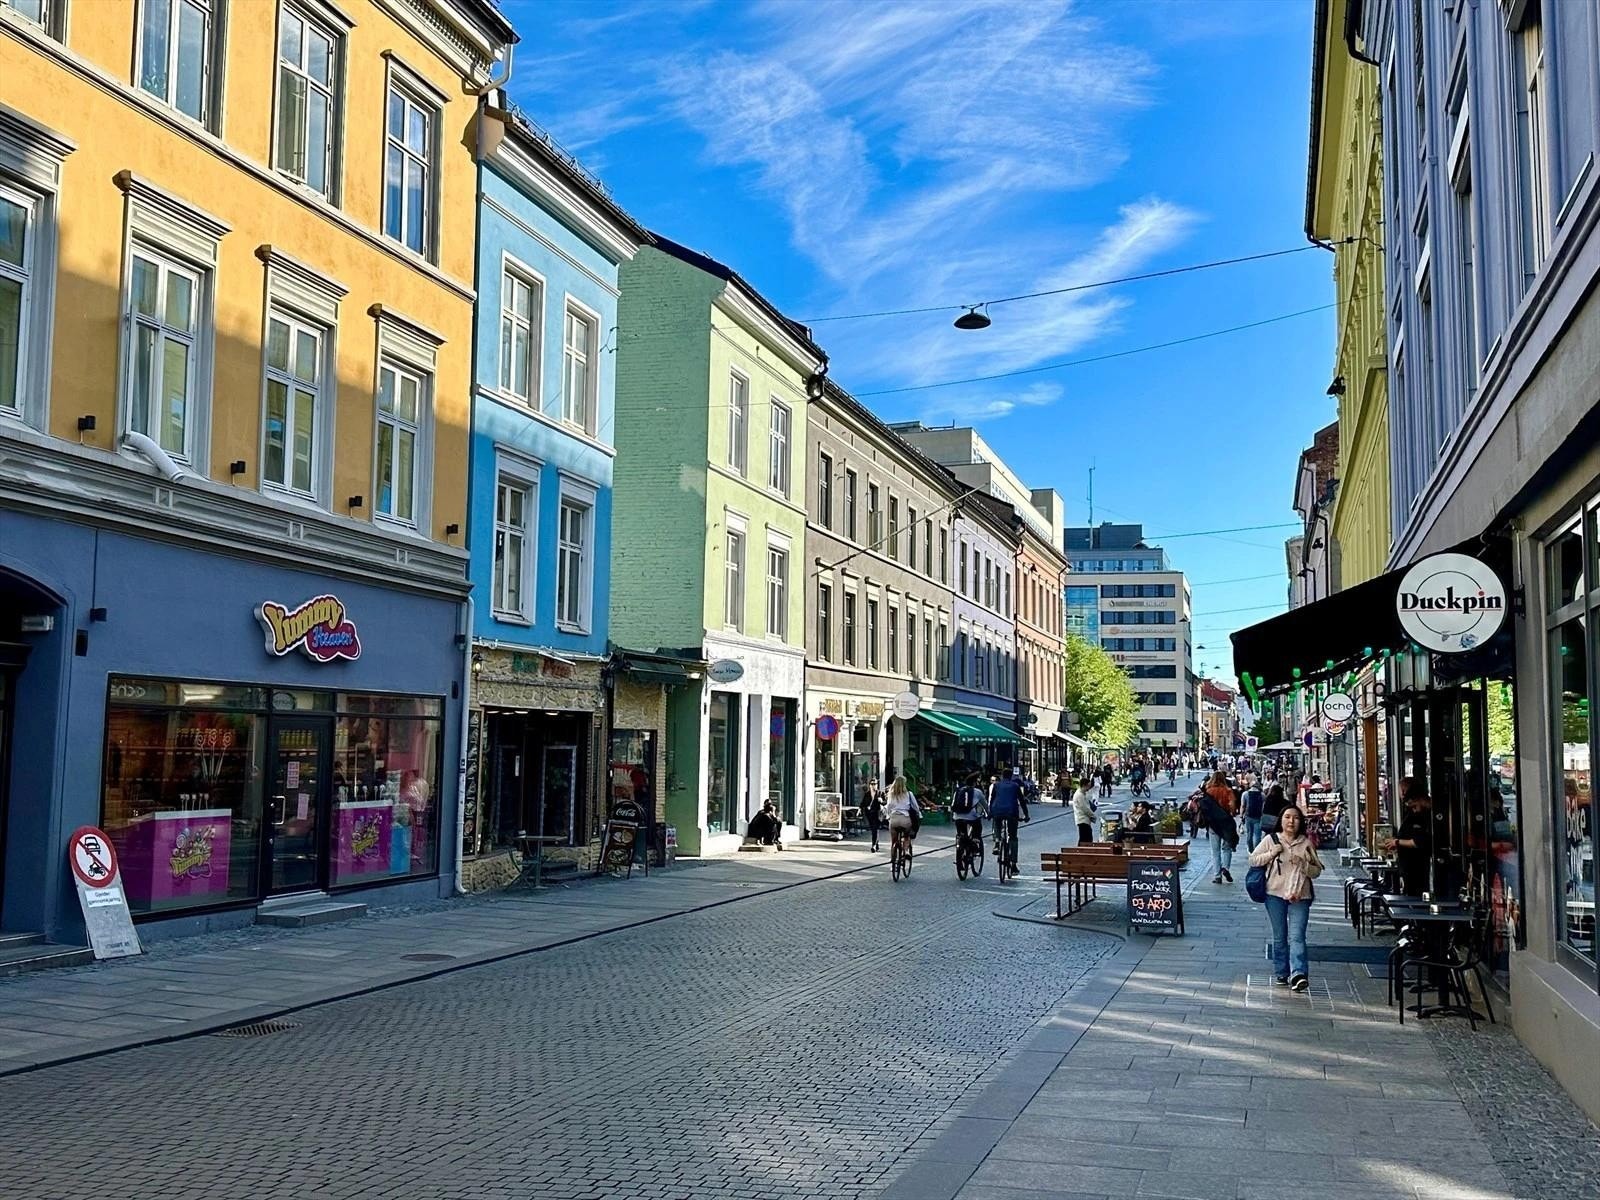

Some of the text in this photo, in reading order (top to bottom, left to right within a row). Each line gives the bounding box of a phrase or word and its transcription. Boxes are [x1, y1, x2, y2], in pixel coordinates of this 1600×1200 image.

[1400, 586, 1502, 614] Duckpin
[264, 599, 342, 651] Yummy
[312, 626, 352, 648] Heaven
